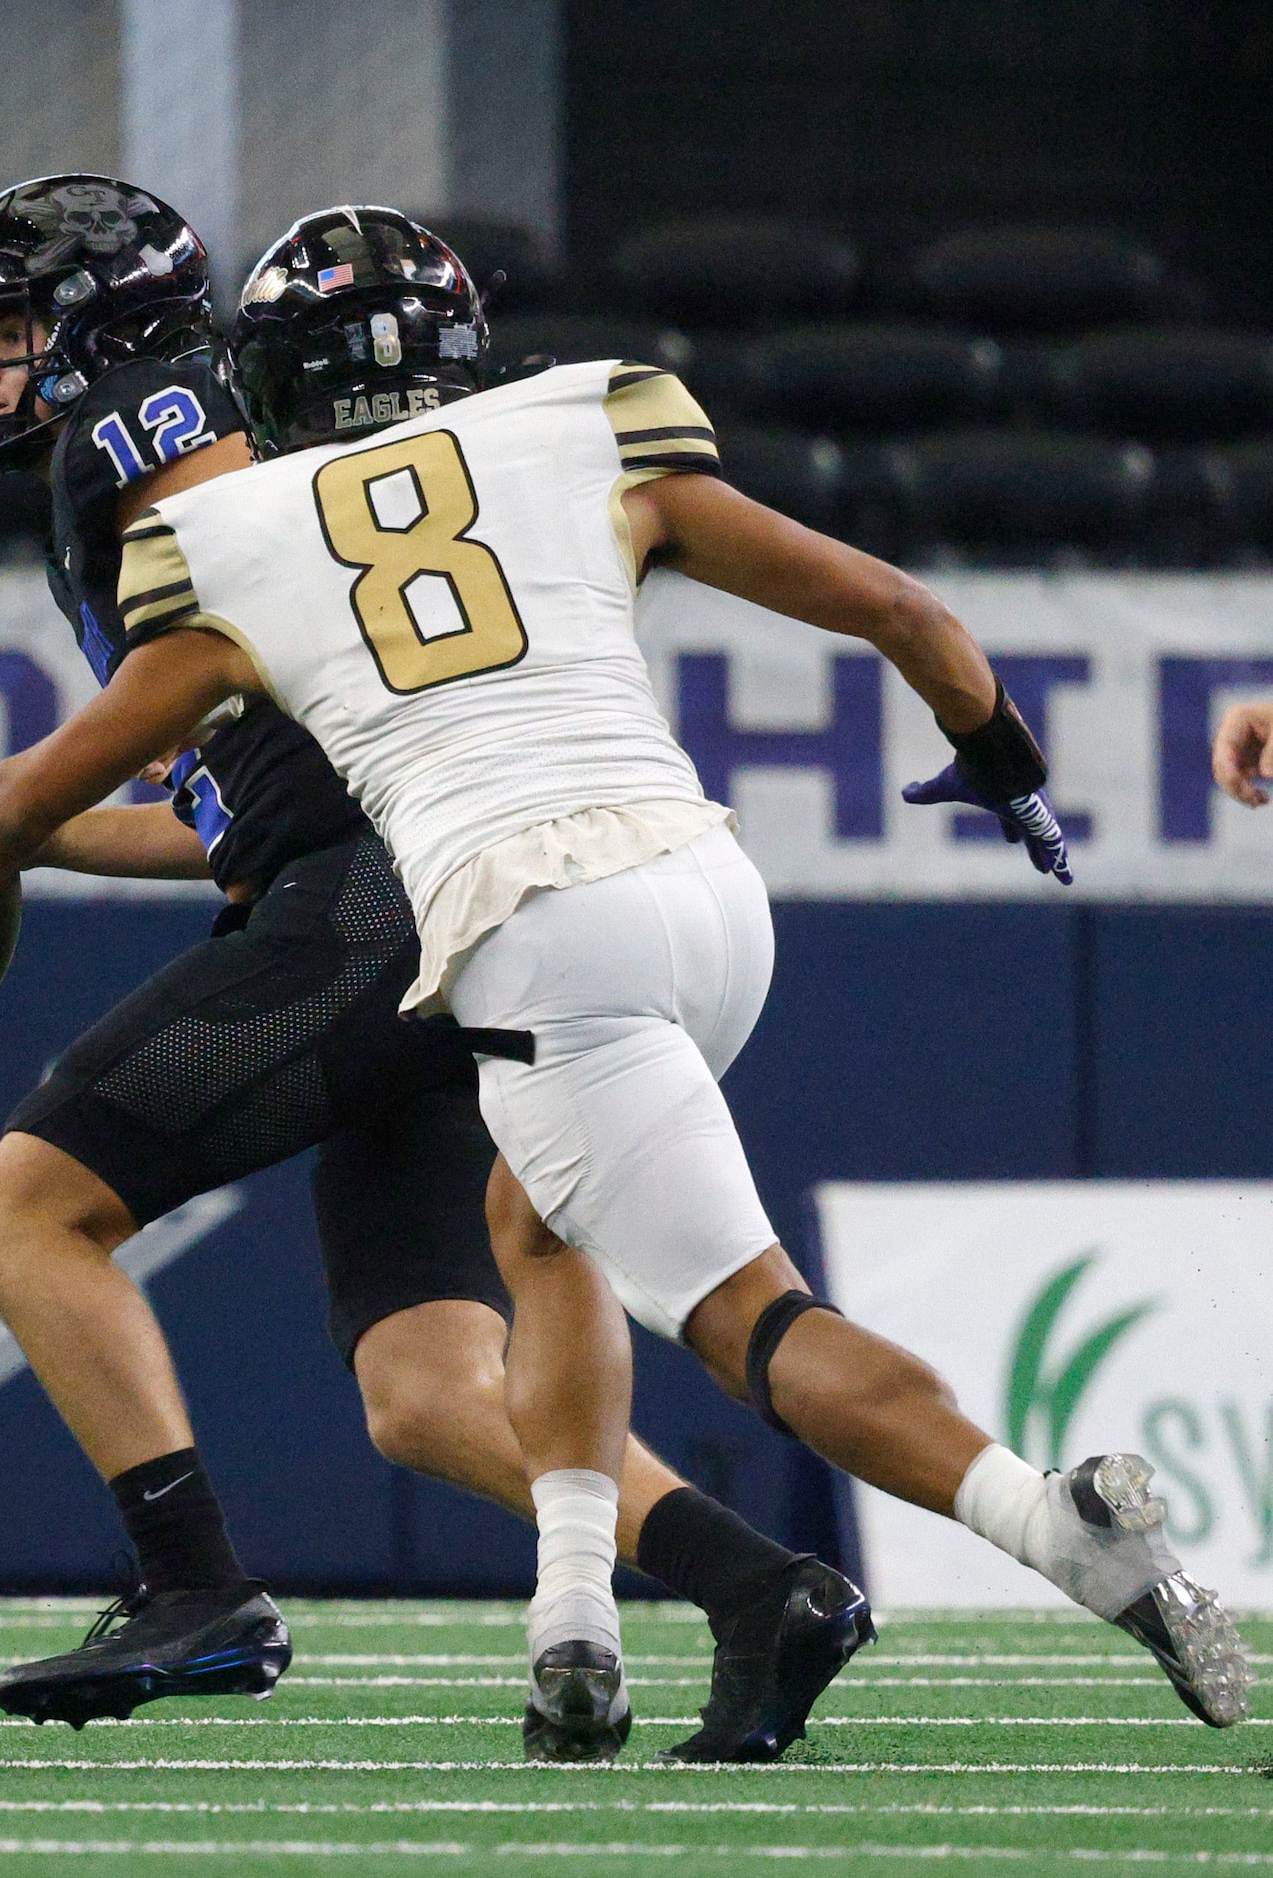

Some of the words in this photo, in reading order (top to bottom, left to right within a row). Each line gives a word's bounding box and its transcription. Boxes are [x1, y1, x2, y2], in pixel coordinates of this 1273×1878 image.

[370, 313, 402, 367] 8
[91, 384, 218, 489] 12
[333, 388, 441, 431] EAGLES
[312, 428, 529, 695] 8
